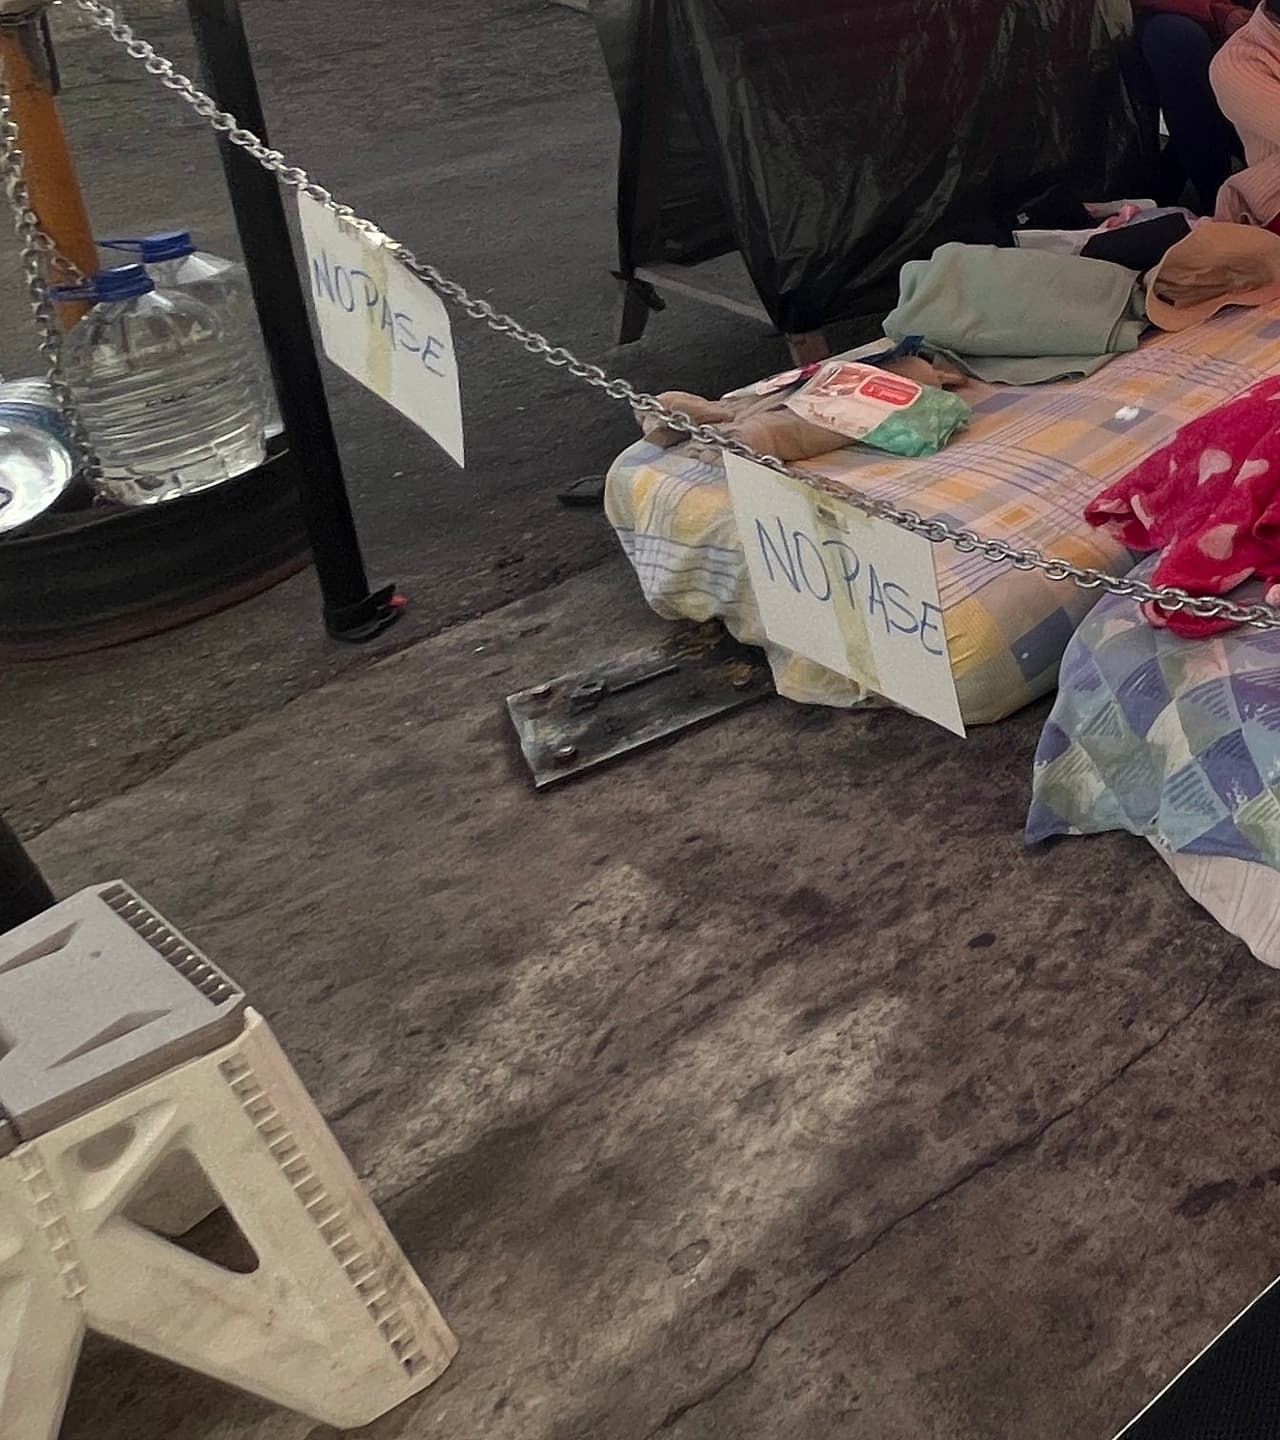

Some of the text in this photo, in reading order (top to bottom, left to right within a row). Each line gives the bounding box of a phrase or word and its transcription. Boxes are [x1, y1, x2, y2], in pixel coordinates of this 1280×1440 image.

[312, 258, 446, 378] NO PASE
[755, 516, 945, 658] NO PASE
